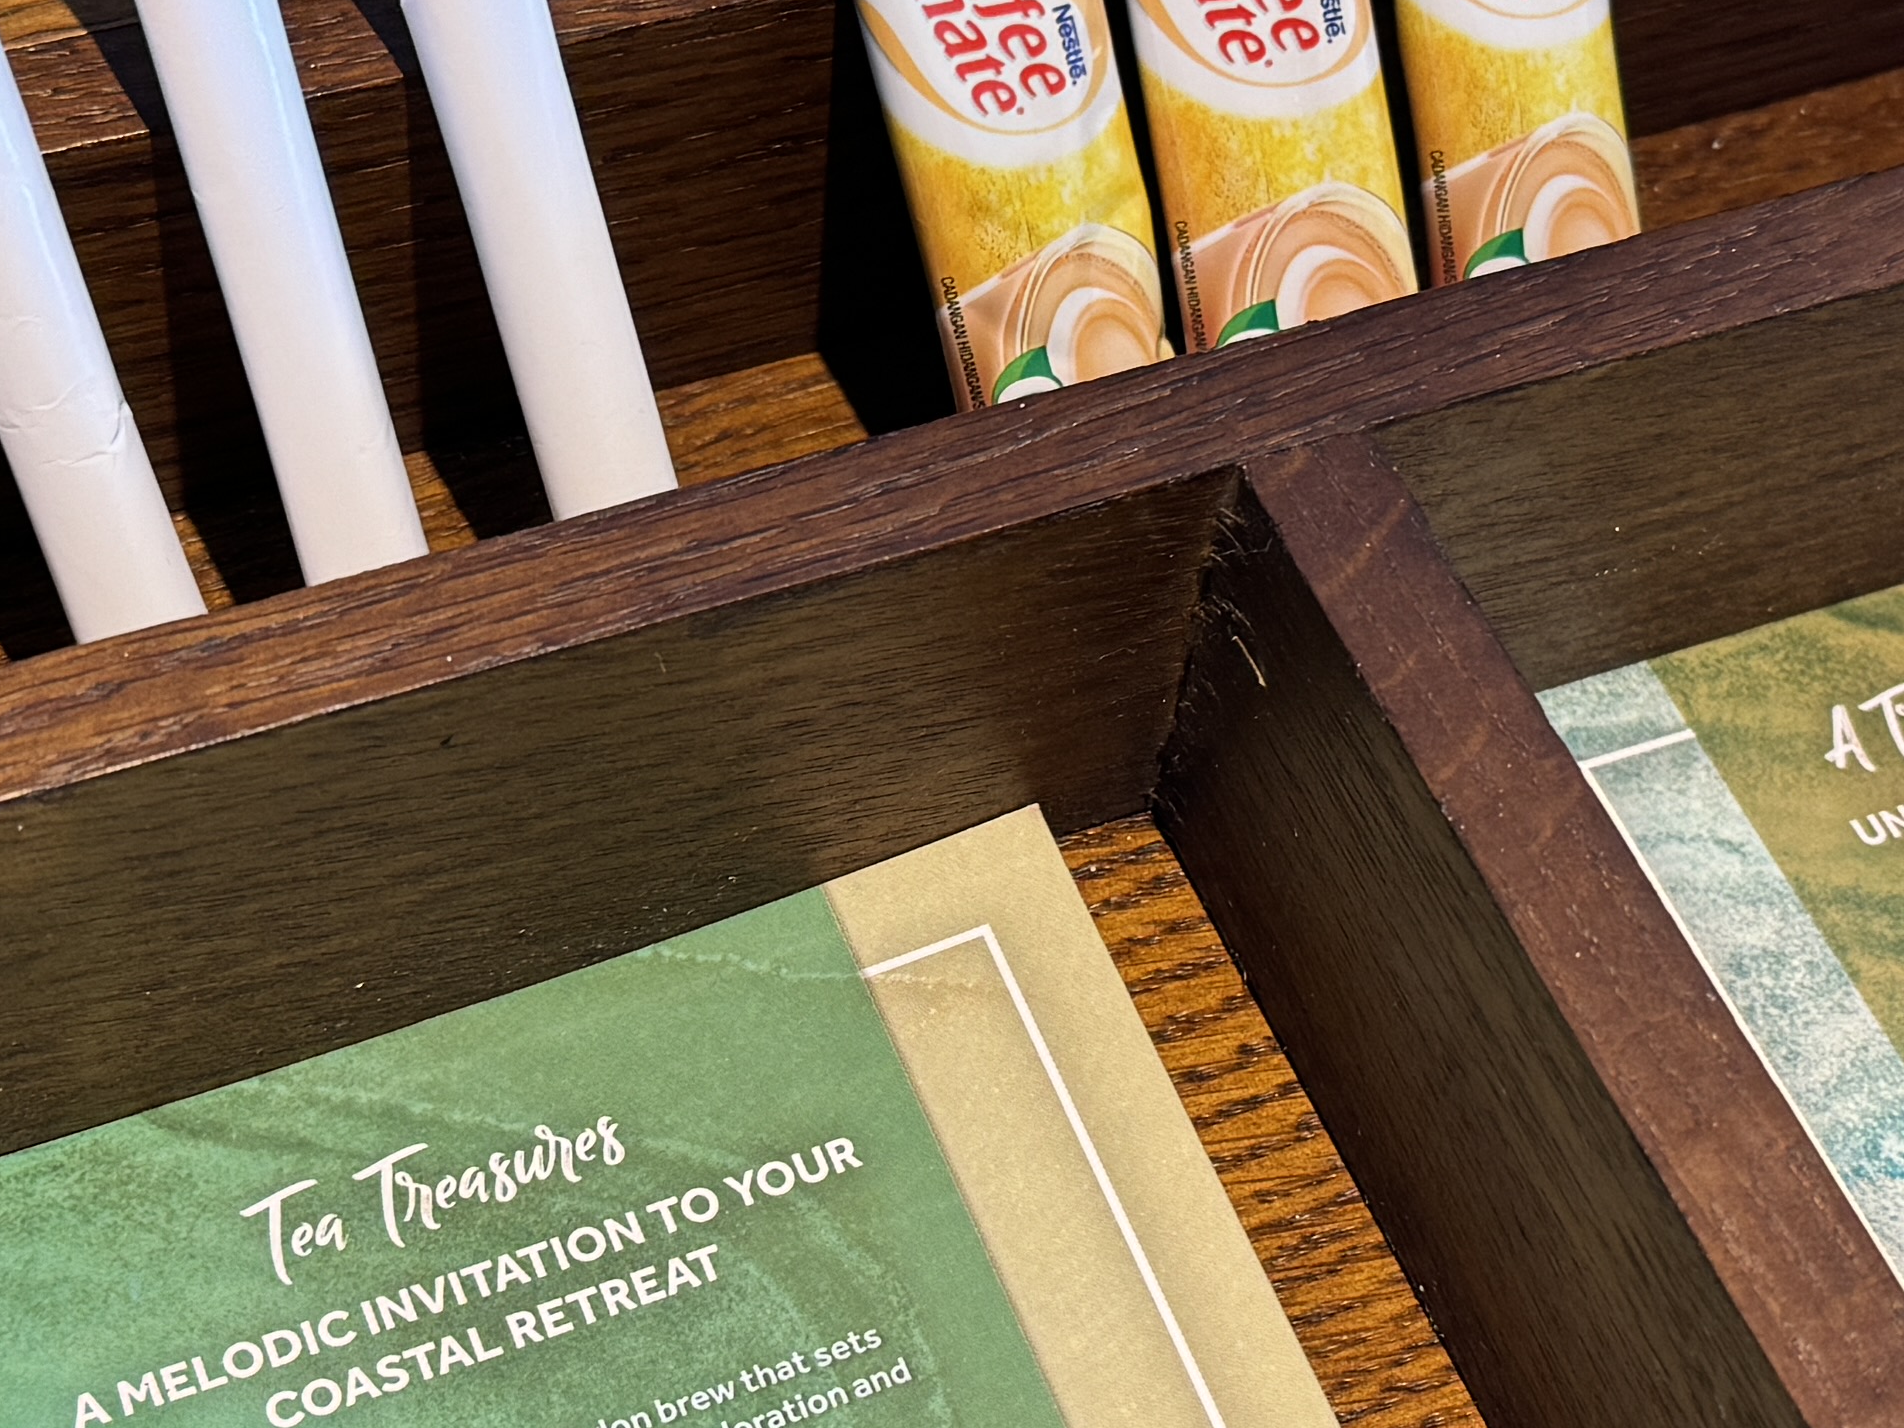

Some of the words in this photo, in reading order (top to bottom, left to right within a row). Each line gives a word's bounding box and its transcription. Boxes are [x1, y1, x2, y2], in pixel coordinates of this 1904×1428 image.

[1430, 149, 1451, 213] CADANGAN
[1175, 220, 1196, 286] CADANGAN
[940, 276, 968, 341] CADANGAN
[1822, 703, 1879, 774] A
[238, 1177, 348, 1287] Tea
[350, 1114, 626, 1249] Treasures
[115, 1309, 358, 1418] MELODIC
[359, 1209, 647, 1336] INVITATION
[644, 1186, 721, 1235] TO
[721, 1136, 865, 1208] YOUR
[503, 1242, 719, 1350] RETREAT
[652, 1379, 735, 1425] brew
[738, 1350, 812, 1393] that
[812, 1327, 883, 1369] sets
